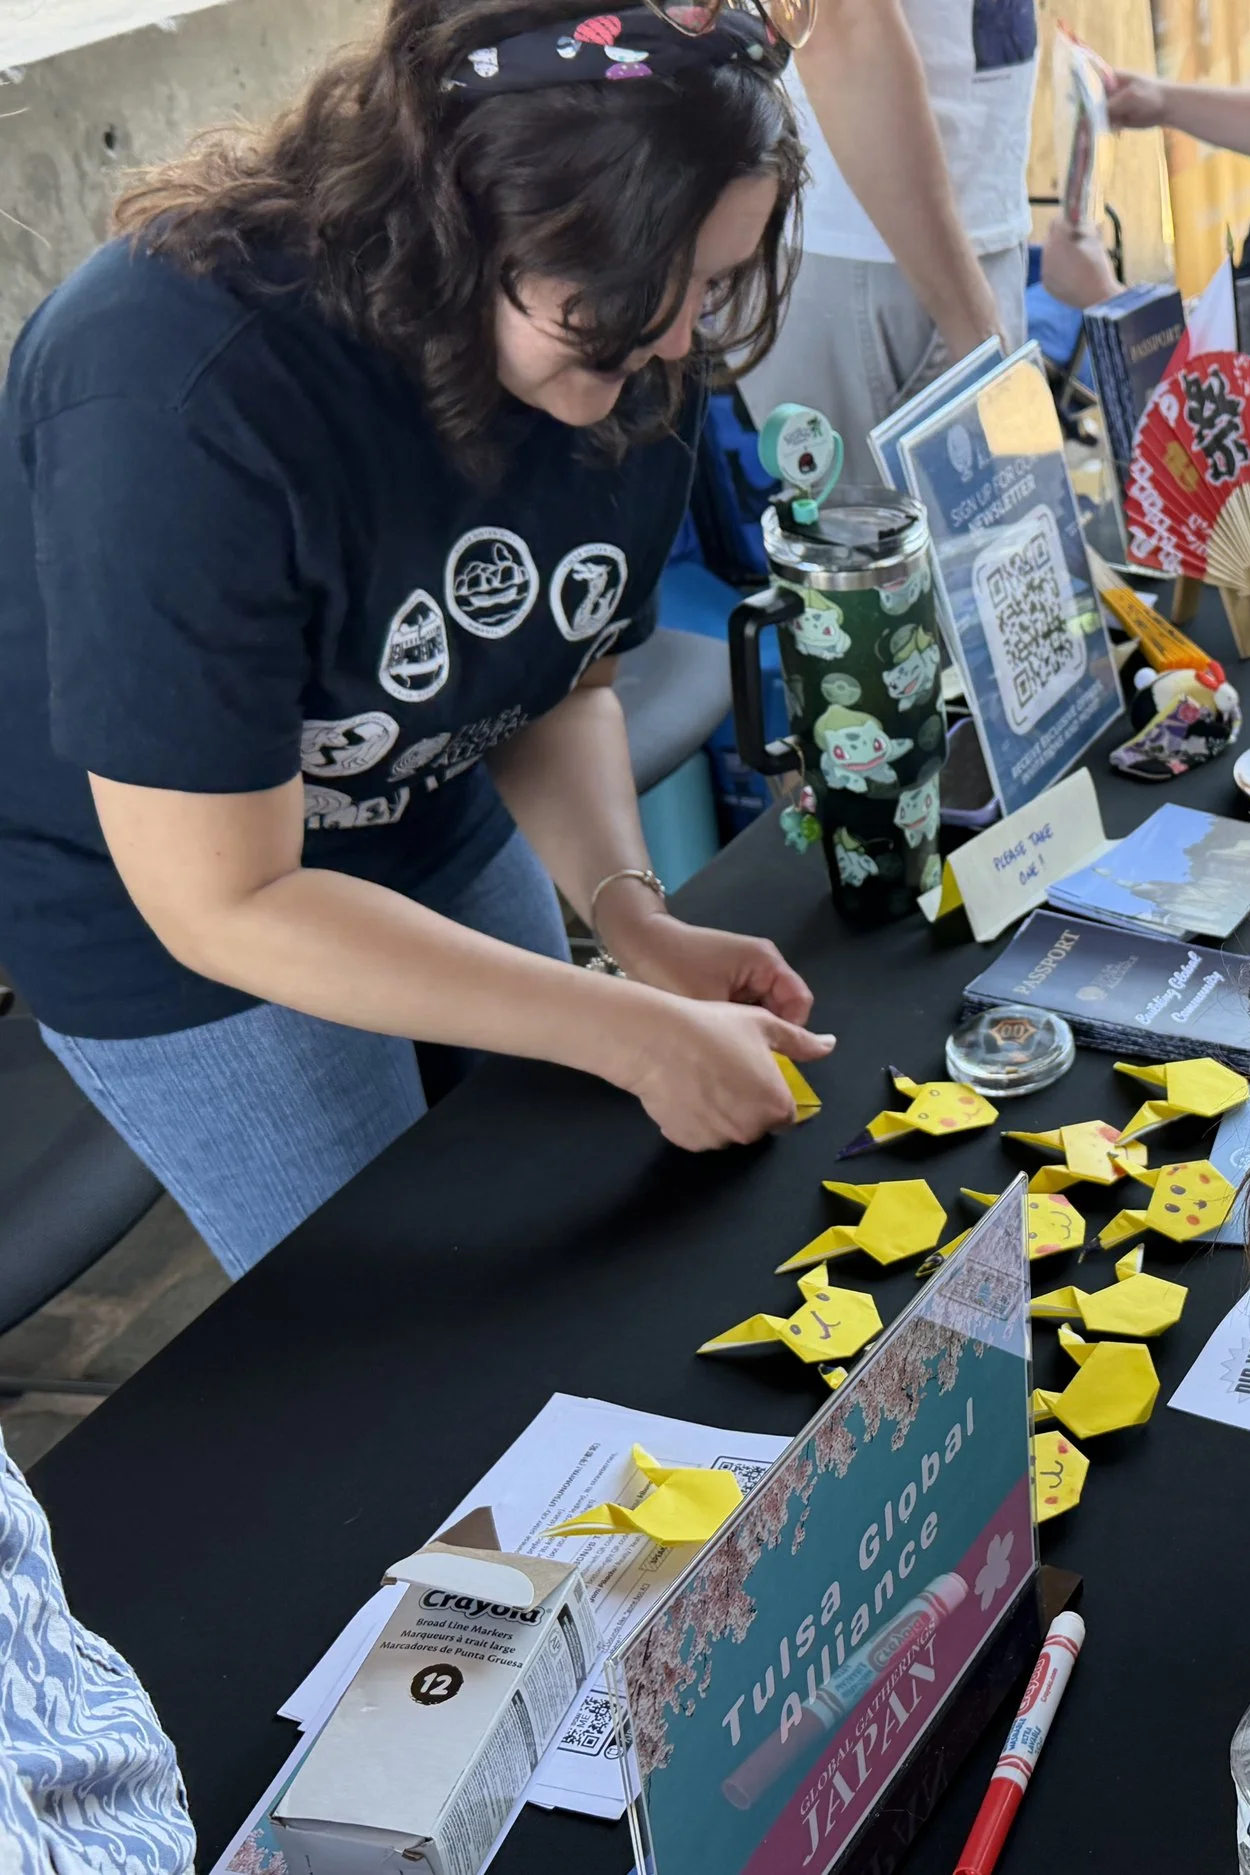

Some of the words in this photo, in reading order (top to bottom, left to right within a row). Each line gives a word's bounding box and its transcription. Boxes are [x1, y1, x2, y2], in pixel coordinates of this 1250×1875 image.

[1131, 324, 1182, 362] PASSPORT
[1181, 366, 1250, 485] 祭
[993, 840, 1027, 871] PLEASE
[1028, 823, 1053, 846] TAKE
[1012, 929, 1080, 995] PASSPORT
[1135, 986, 1182, 1025] Building
[1168, 950, 1203, 990] Global
[1171, 971, 1225, 1023] Community
[722, 1580, 841, 1746] Tulsa
[859, 1397, 974, 1571] Global
[400, 1630, 455, 1642] Marqueurs
[456, 1635, 463, 1643] à
[465, 1637, 488, 1649] trait
[490, 1641, 516, 1655] large
[416, 1618, 445, 1628] Broad
[447, 1622, 469, 1632] Line
[471, 1625, 513, 1640] Markers
[780, 1511, 938, 1744] Alliance
[380, 1642, 437, 1652] Marcadores
[439, 1645, 453, 1653] de
[454, 1648, 485, 1660] Punta
[487, 1654, 523, 1669] Gruesa
[420, 1672, 452, 1695] 12
[577, 1713, 589, 1728] ME
[800, 1740, 854, 1816] GLOBAL
[855, 1618, 937, 1737] GATHERINGS
[1008, 1718, 1027, 1751] WASHABLE
[1028, 1725, 1042, 1755] LAVABLE
[802, 1633, 937, 1867] JAPAN
